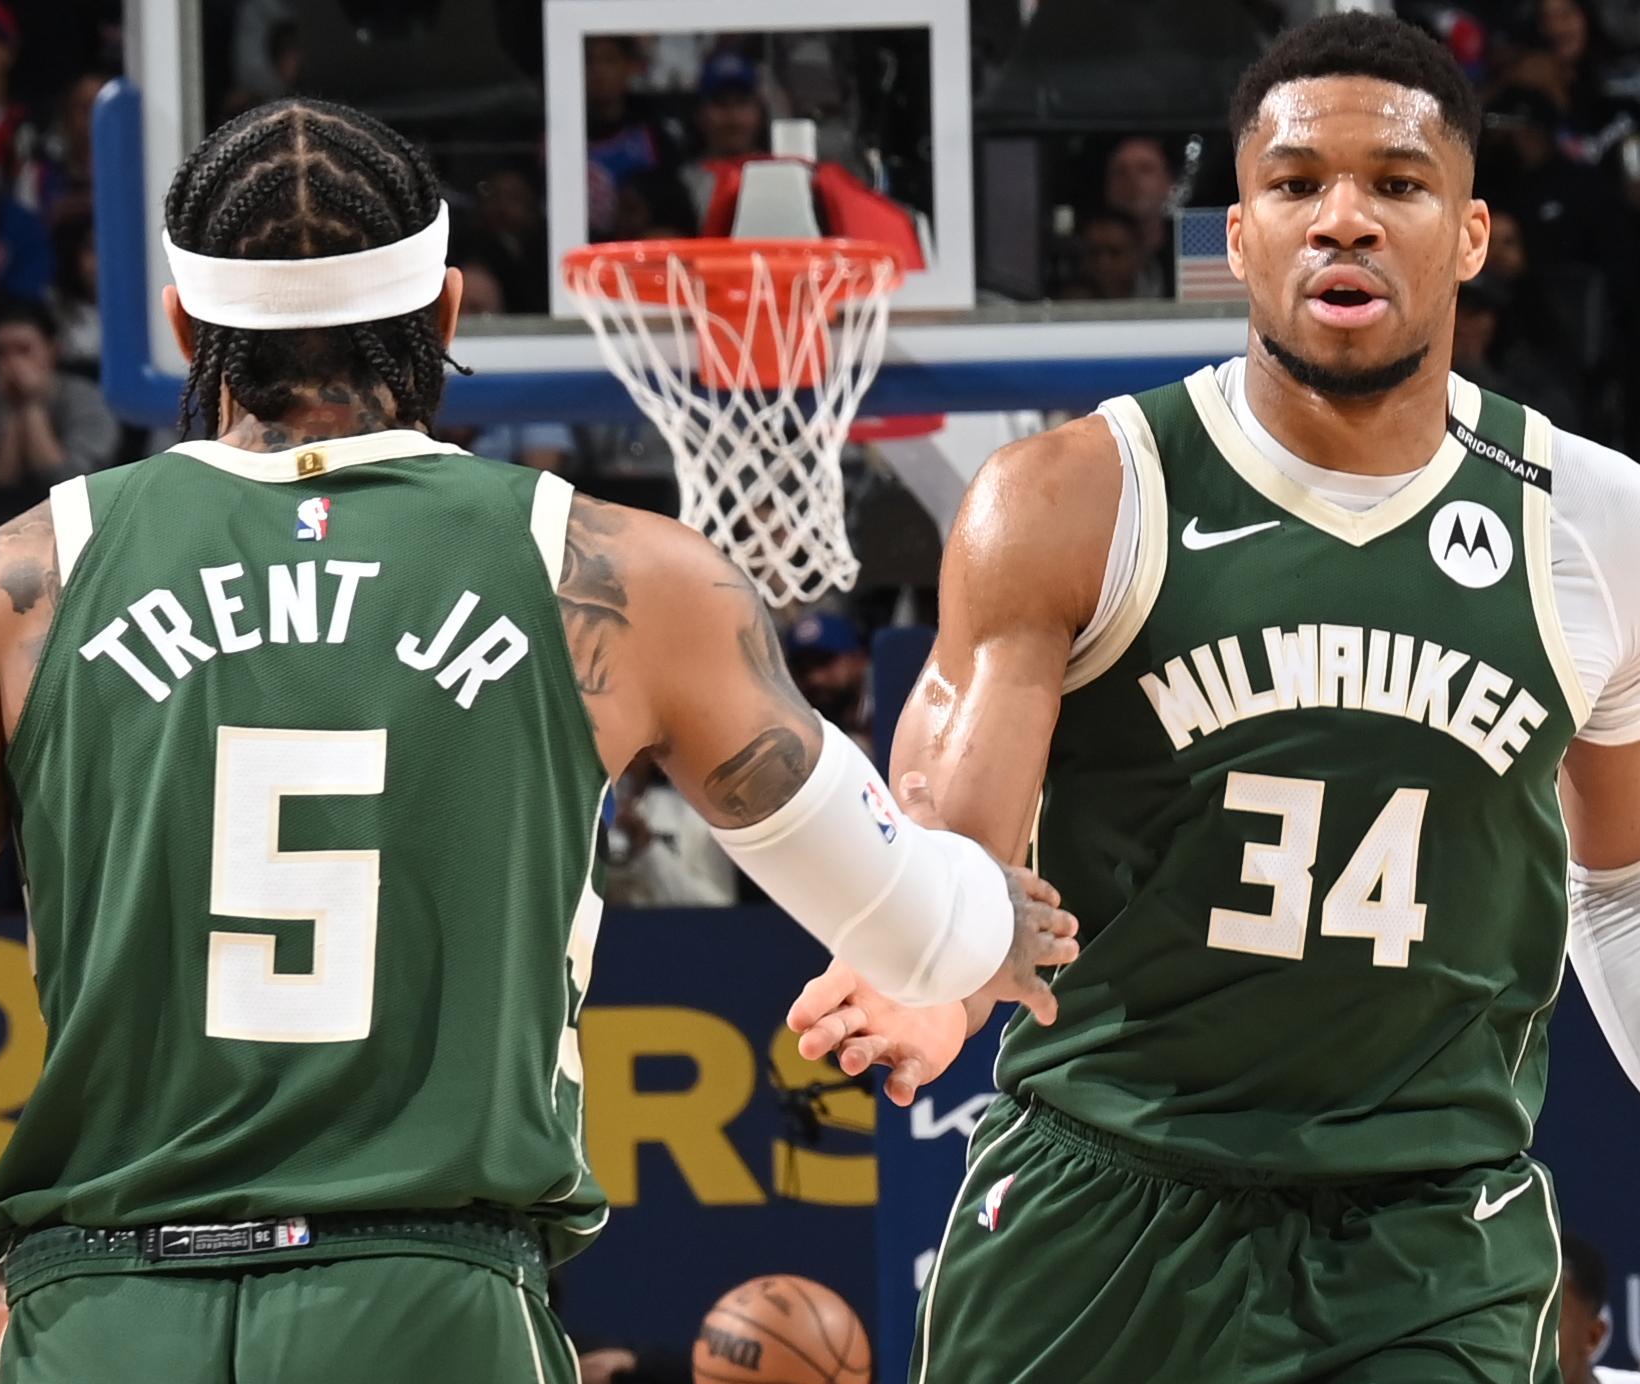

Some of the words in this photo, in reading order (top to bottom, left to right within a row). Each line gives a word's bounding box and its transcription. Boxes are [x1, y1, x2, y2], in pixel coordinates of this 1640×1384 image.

[1456, 424, 1539, 482] BRIDGEMAN
[79, 560, 381, 703] TRENT
[395, 590, 529, 709] JR
[1137, 623, 1549, 777] MILWAUKEE
[205, 725, 388, 1043] 5
[1206, 771, 1430, 968] 34
